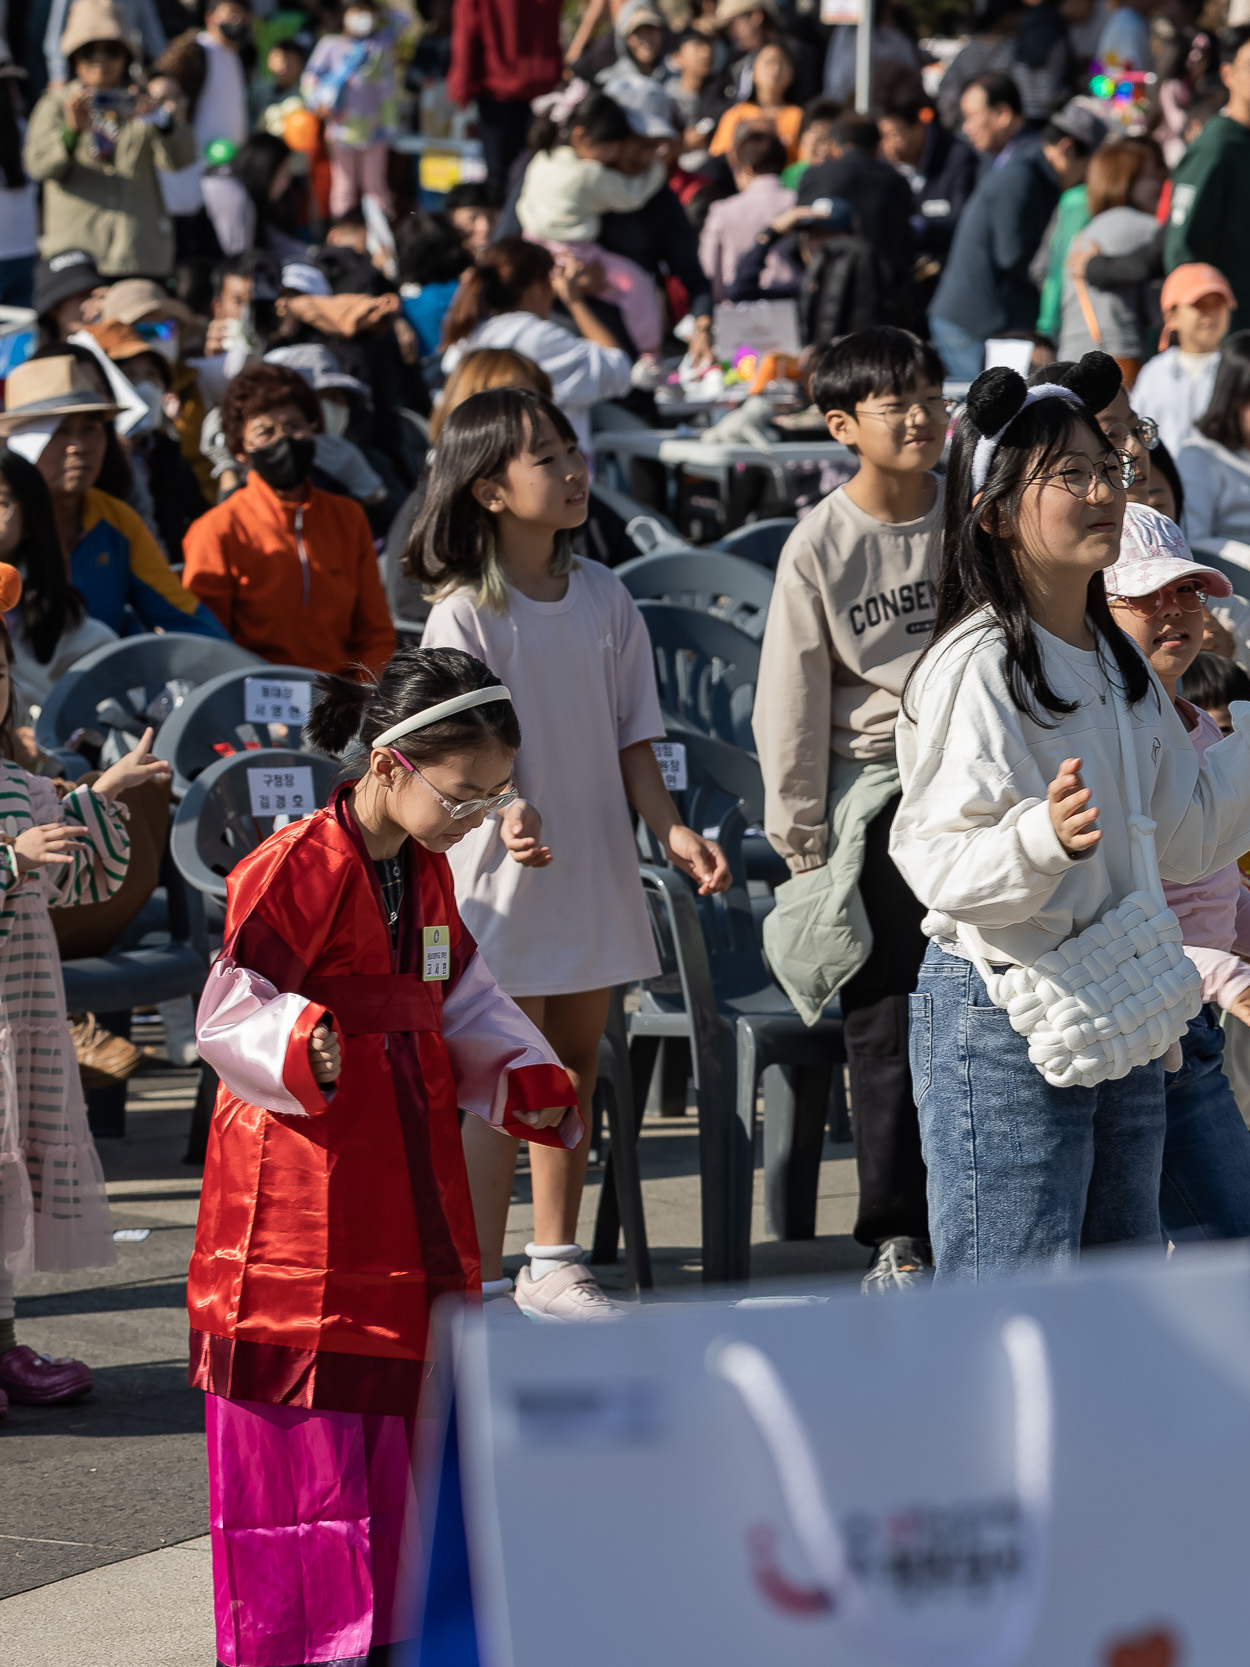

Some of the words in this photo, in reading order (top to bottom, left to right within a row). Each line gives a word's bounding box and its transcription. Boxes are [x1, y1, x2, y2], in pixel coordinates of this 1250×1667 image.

[263, 773, 295, 789] 구청장
[259, 794, 270, 810] 김
[292, 794, 304, 808] 호
